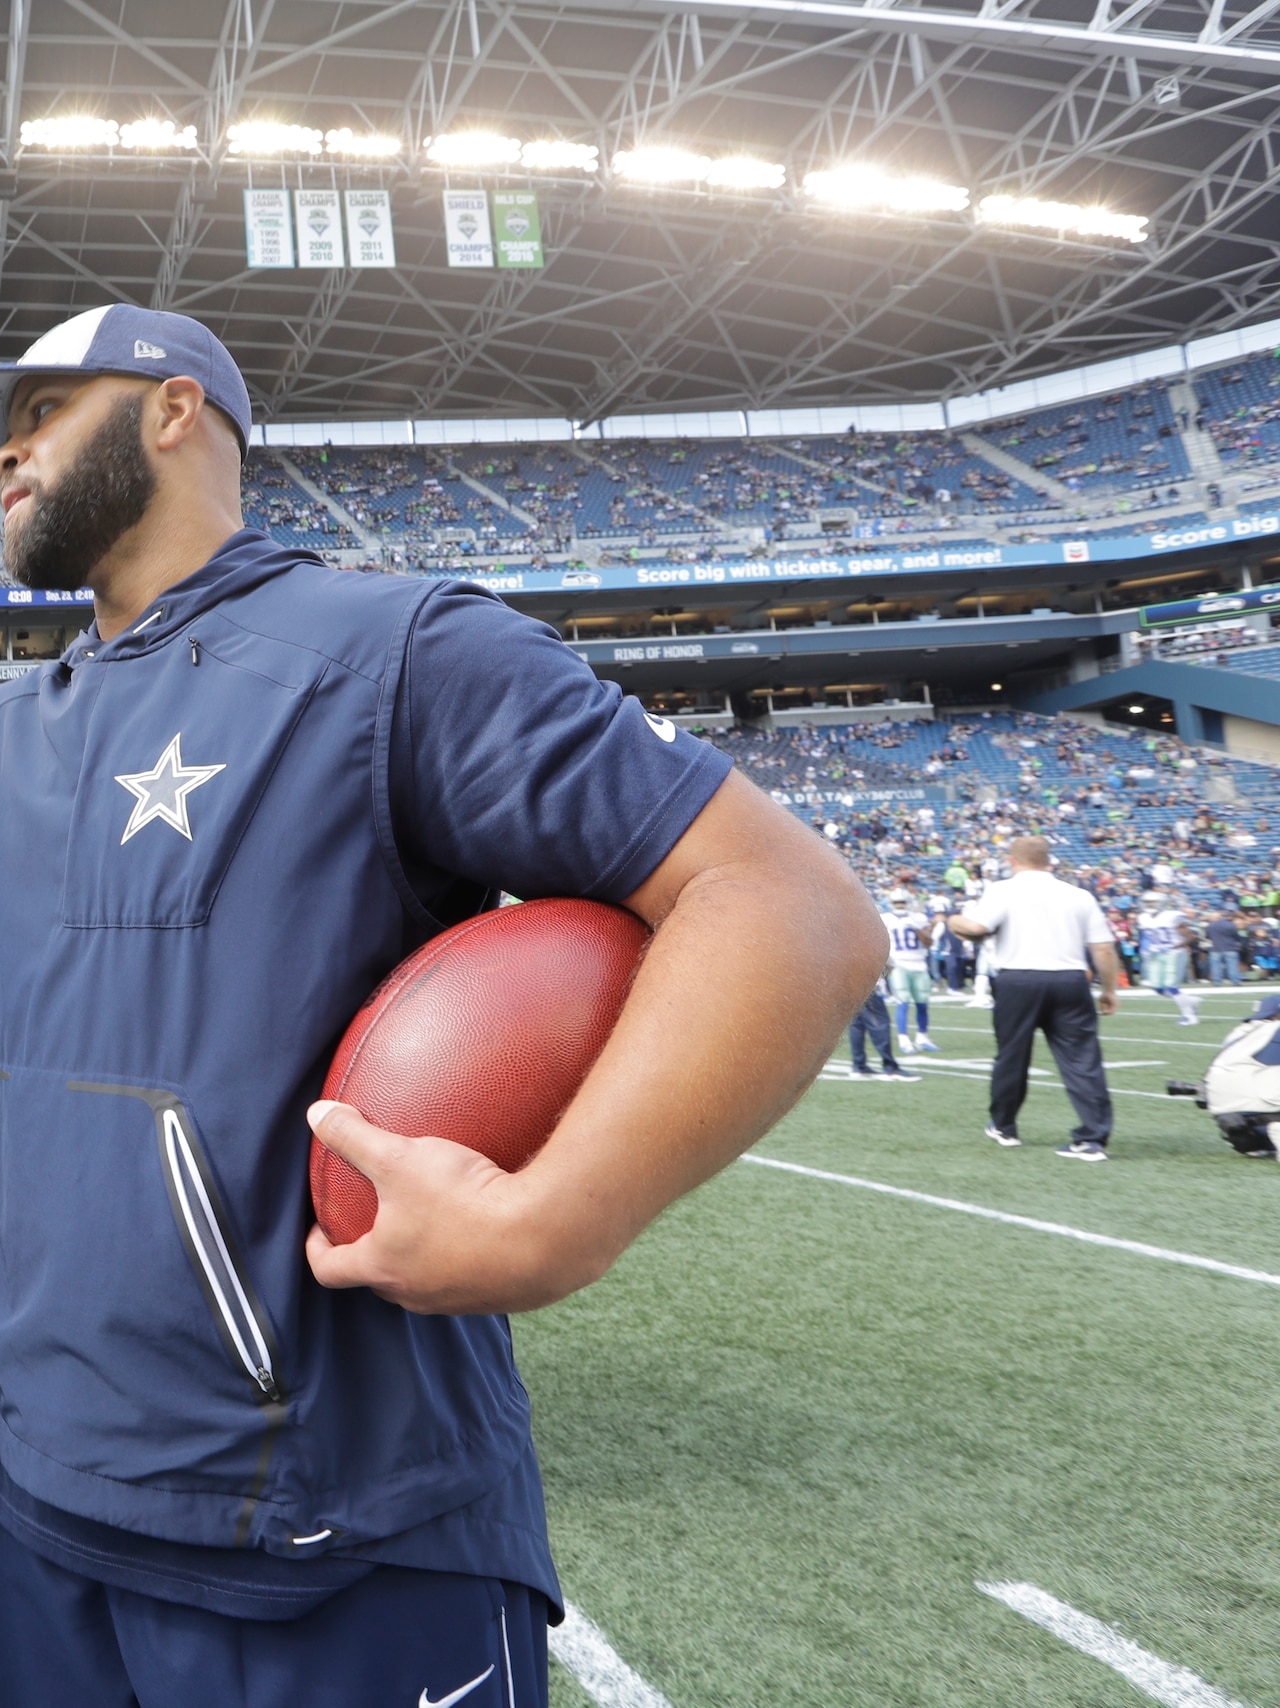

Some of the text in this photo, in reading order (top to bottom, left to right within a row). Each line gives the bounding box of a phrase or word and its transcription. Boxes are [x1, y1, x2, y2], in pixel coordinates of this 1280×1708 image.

[309, 242, 332, 250] 2009
[360, 242, 382, 250] 2011
[310, 252, 333, 261] 2010
[361, 252, 384, 261] 2014
[1150, 517, 1279, 549] Score big
[637, 549, 1002, 583] Score big with tickets, gear, and more!
[614, 644, 704, 661] RING OF HONOR
